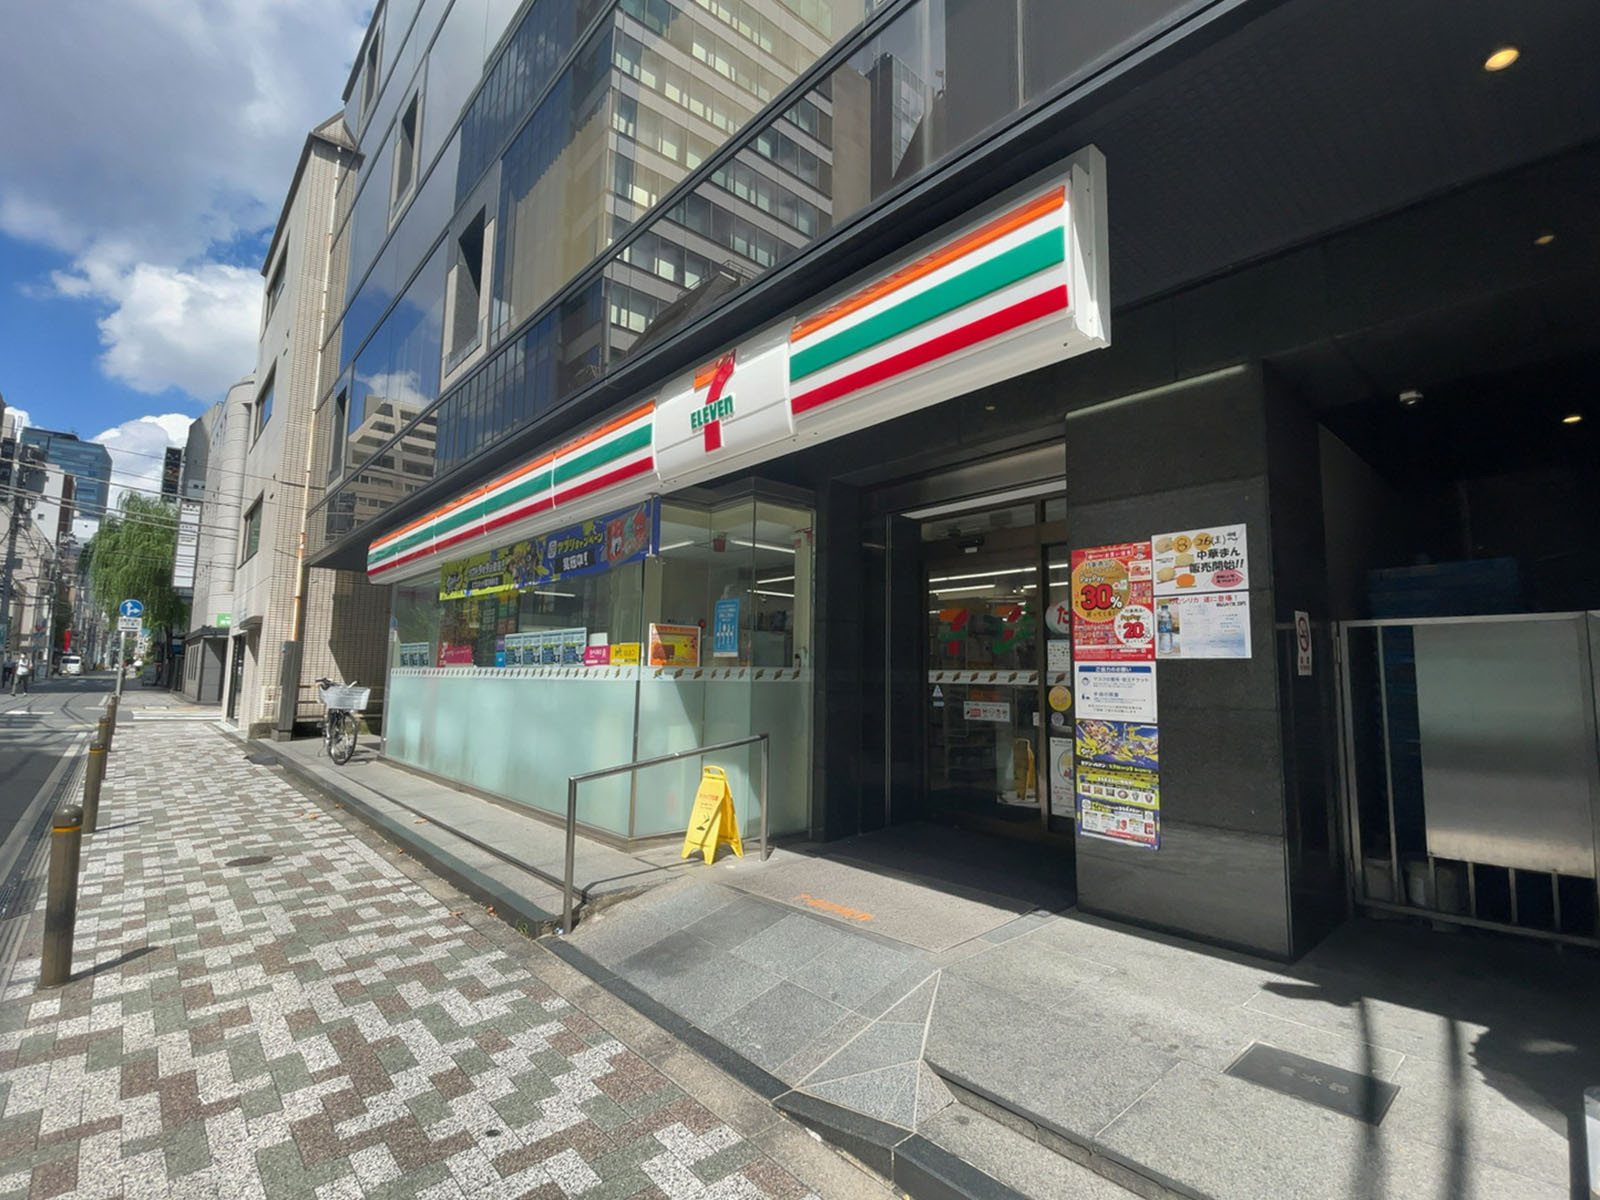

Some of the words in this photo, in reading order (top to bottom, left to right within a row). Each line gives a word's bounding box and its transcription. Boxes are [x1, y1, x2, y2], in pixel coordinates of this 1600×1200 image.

[694, 349, 736, 453] 7
[1196, 546, 1241, 560] 中華まん
